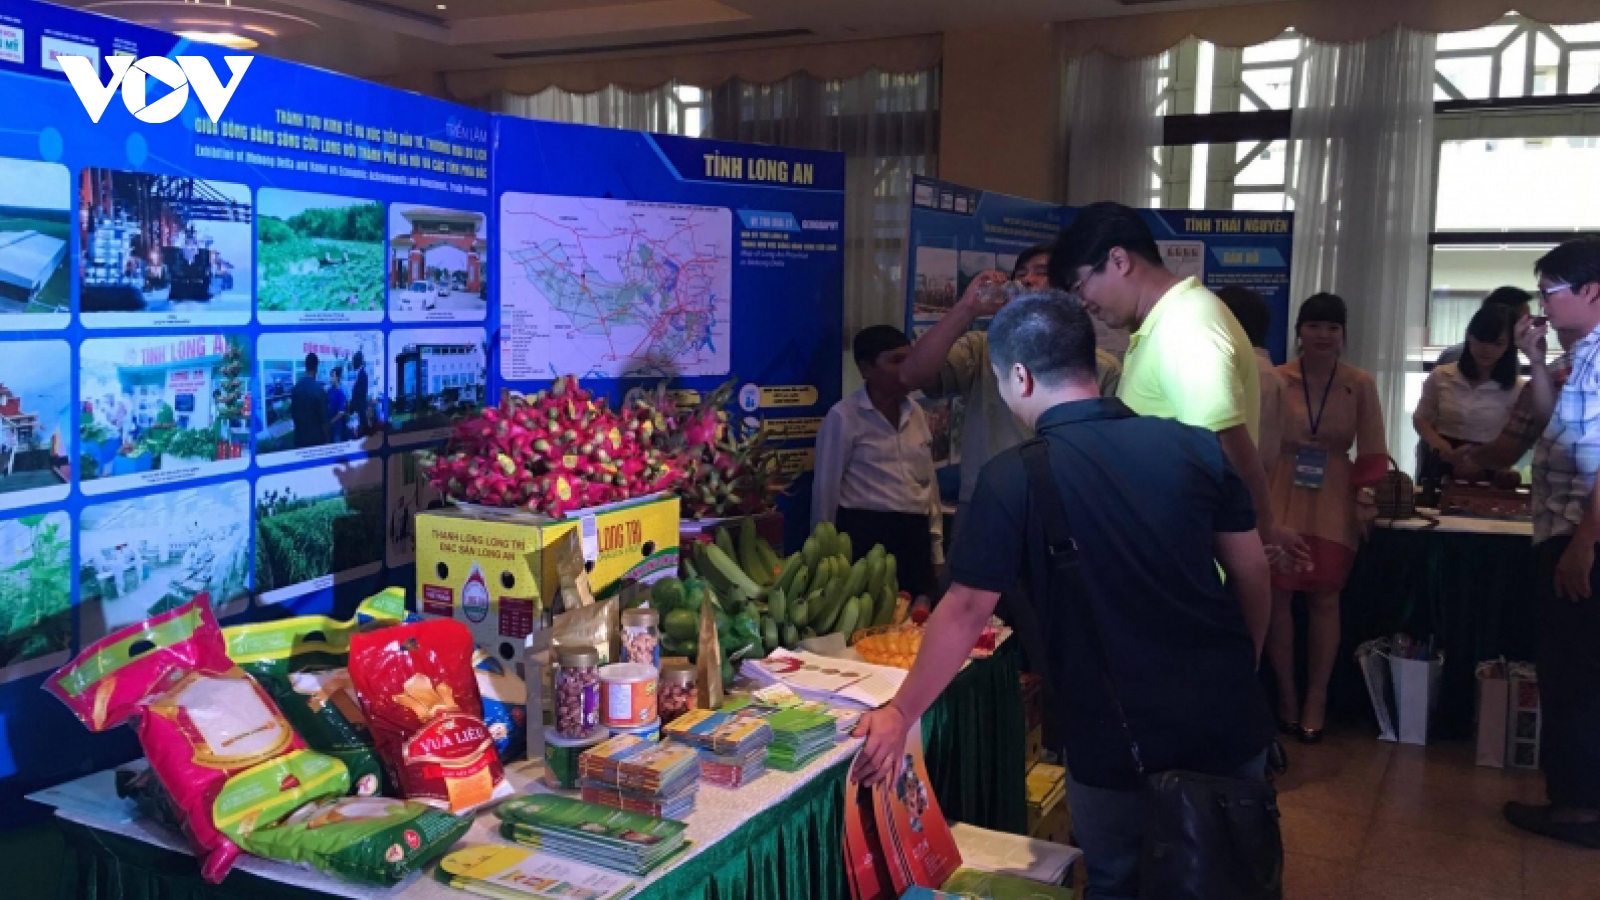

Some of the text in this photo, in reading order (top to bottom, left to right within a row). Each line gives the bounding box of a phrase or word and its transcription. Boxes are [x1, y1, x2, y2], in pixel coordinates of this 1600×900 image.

[703, 149, 813, 185] TỈNH LONG AN
[460, 533, 484, 546] LONG
[486, 537, 510, 549] LONG
[419, 734, 453, 757] VUA
